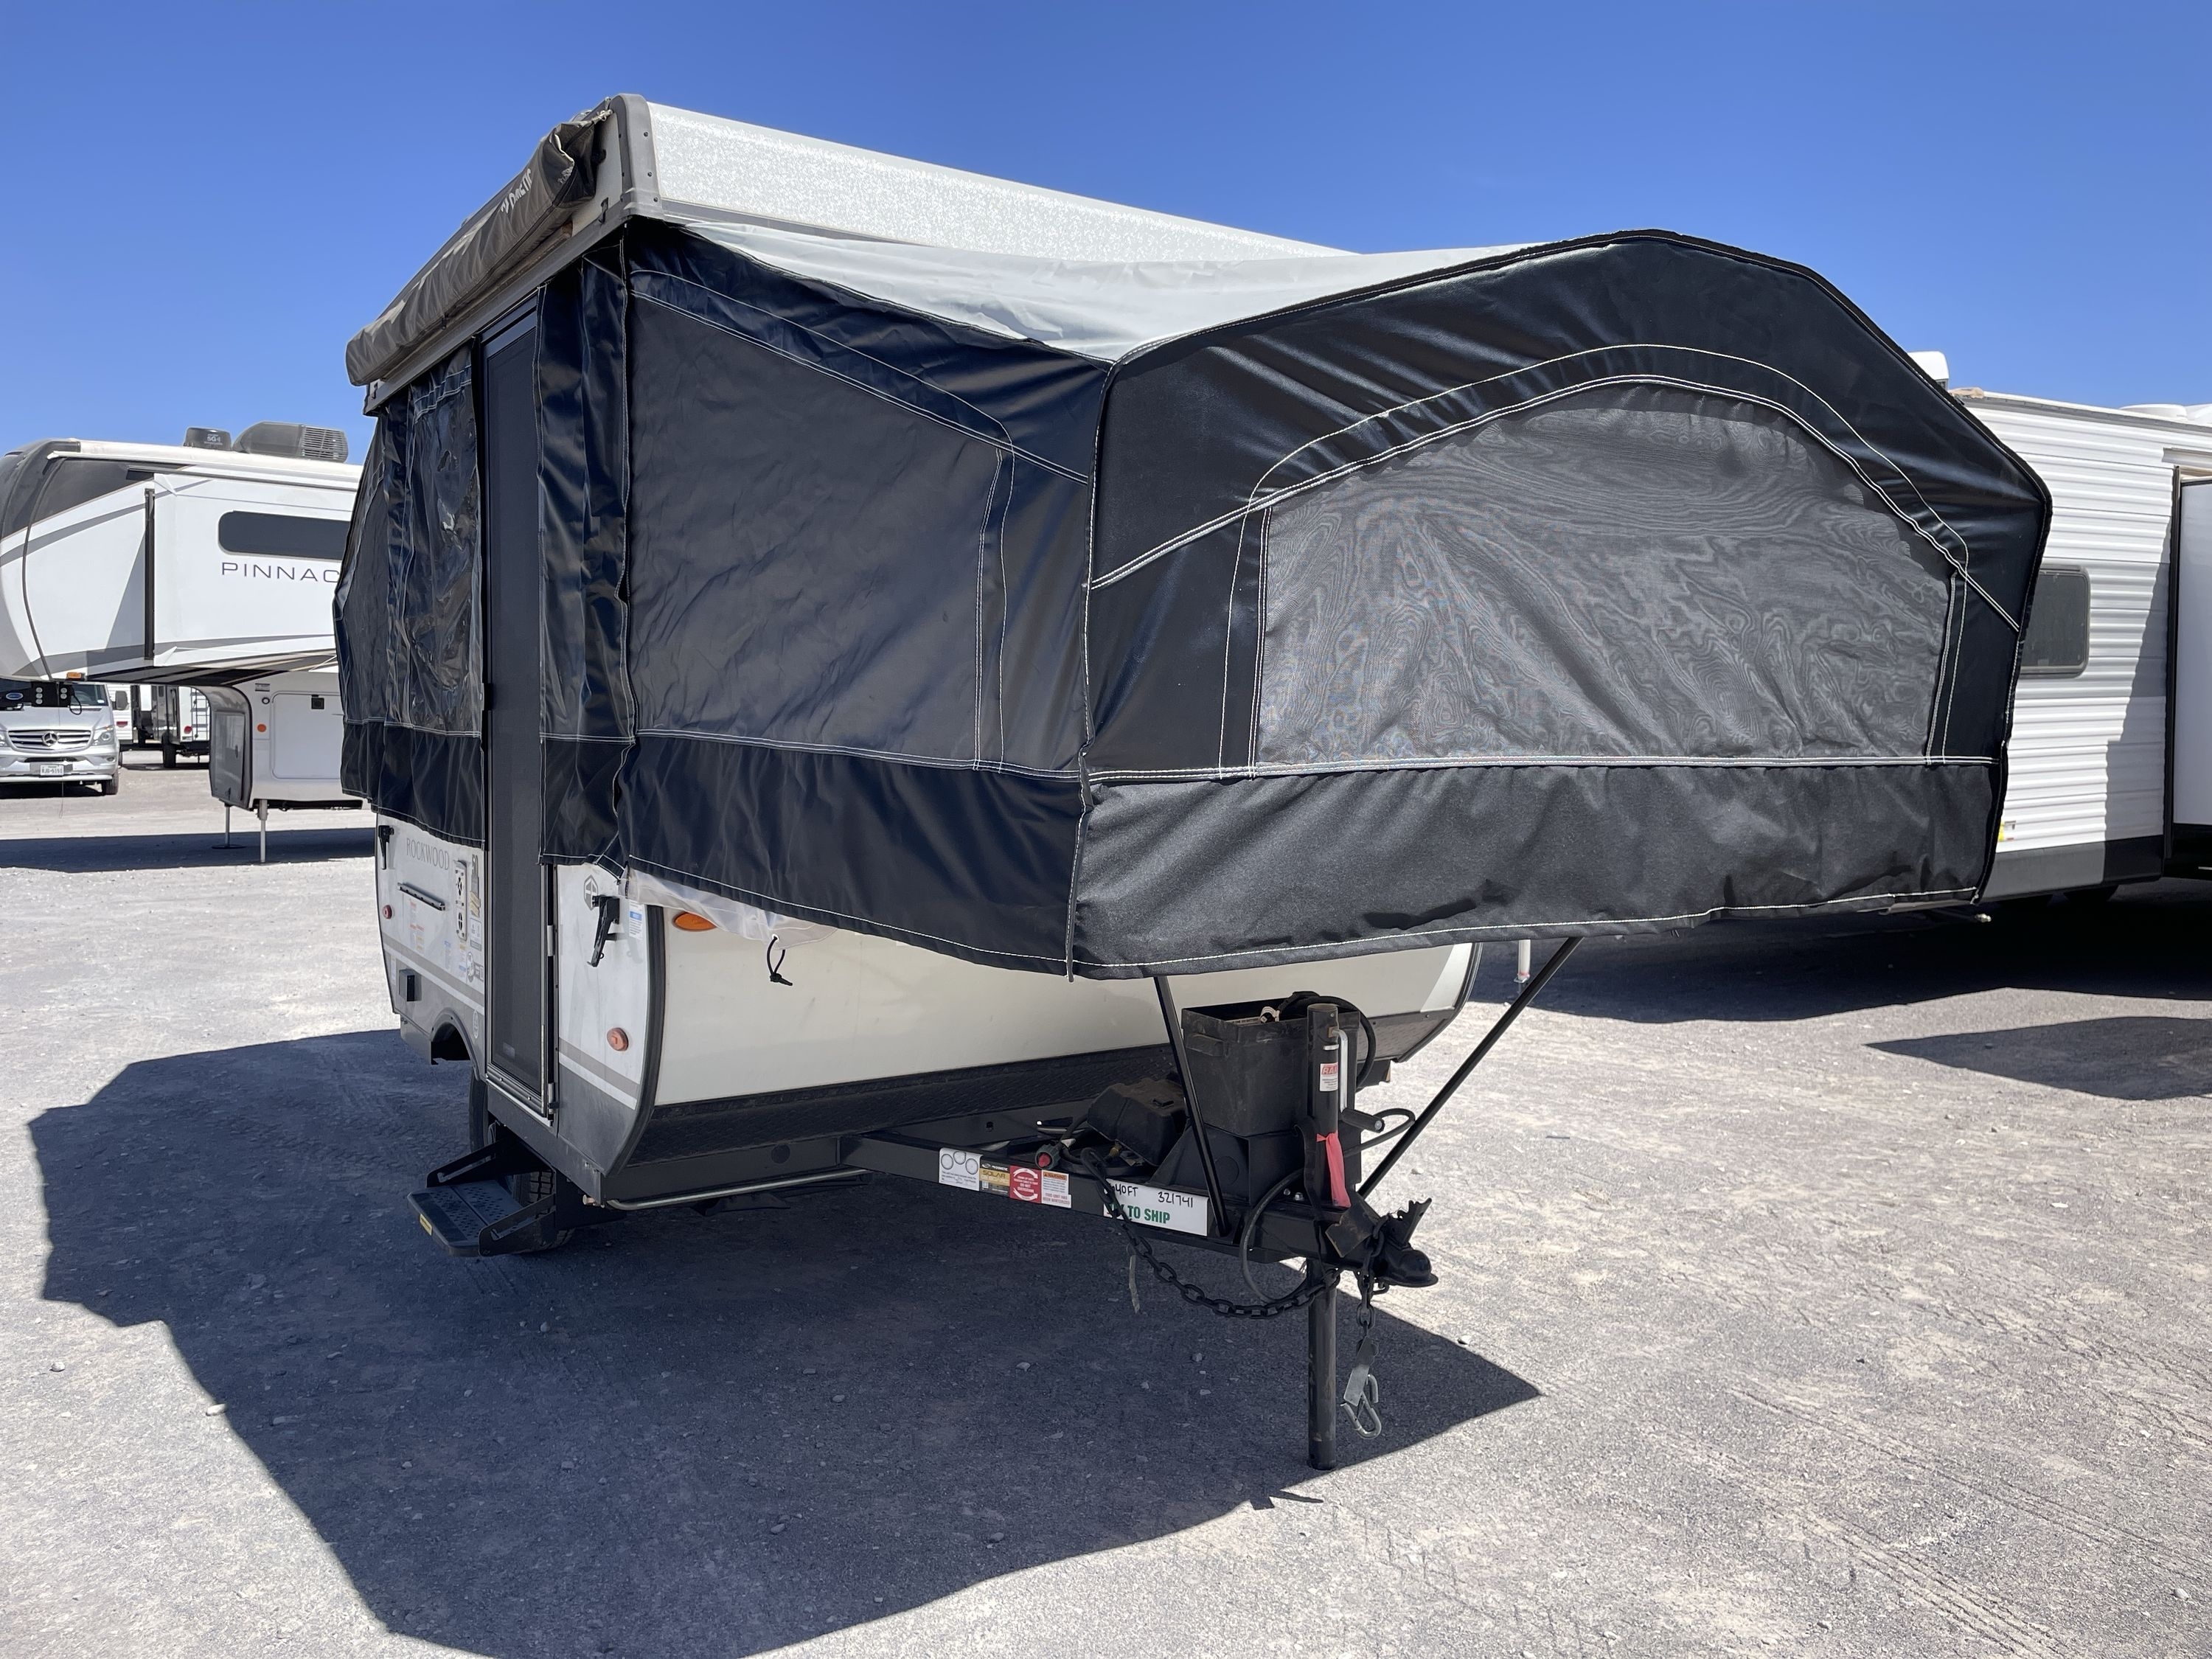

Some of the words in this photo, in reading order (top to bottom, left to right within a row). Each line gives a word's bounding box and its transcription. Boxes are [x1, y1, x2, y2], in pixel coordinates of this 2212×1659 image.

[406, 838, 450, 870] ROCKWOOD
[982, 1169, 1006, 1179] SOLAR
[1112, 1183, 1138, 1197] 40FT
[1158, 1191, 1193, 1208] 321741
[1127, 1205, 1141, 1219] TO
[1144, 1208, 1170, 1224] SHIP
